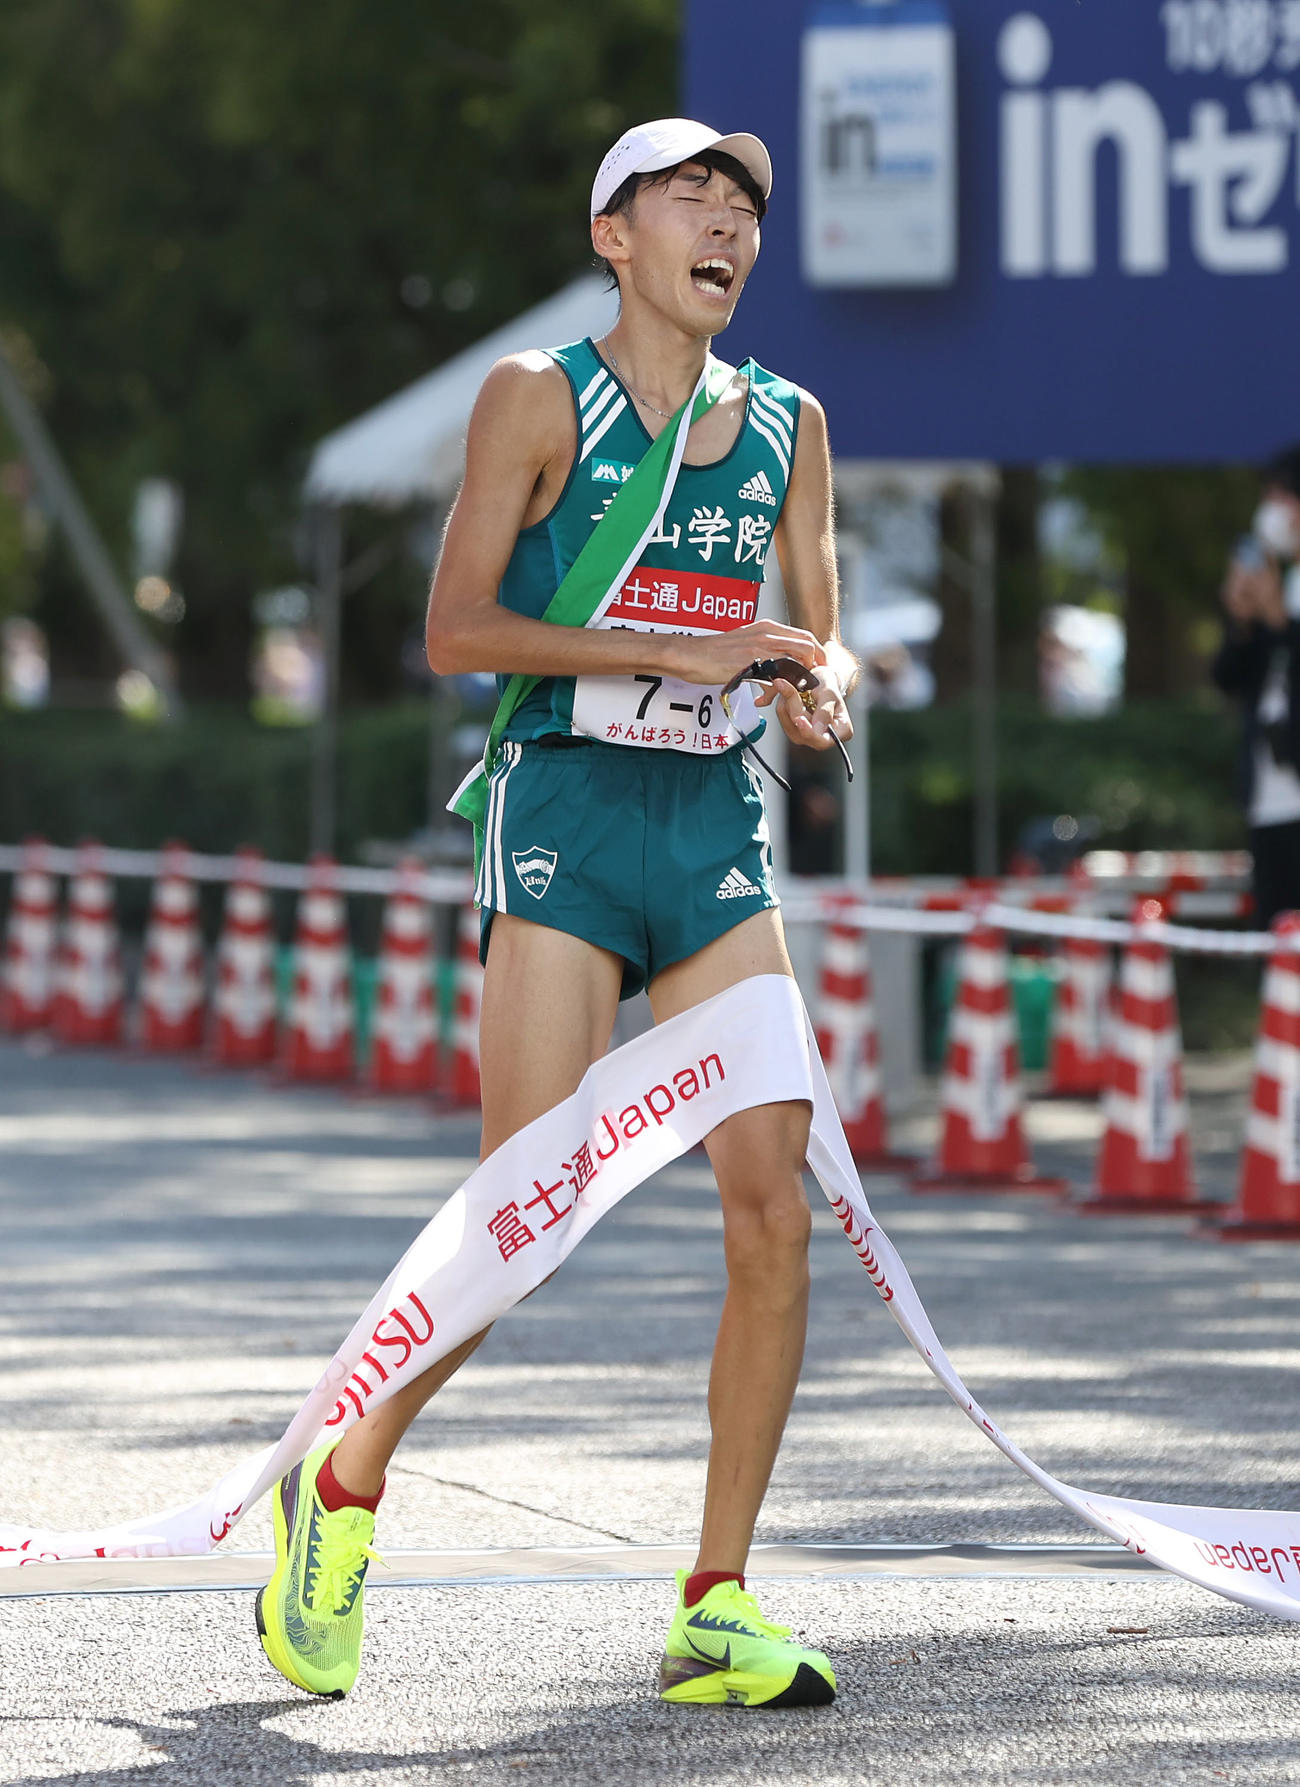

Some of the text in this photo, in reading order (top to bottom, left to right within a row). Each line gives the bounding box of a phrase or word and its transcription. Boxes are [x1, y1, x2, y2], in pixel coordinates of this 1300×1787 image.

[998, 12, 1300, 278] inゼ
[738, 488, 777, 507] adidas
[716, 884, 762, 900] adidas
[487, 1053, 726, 1263] 富士通Japan
